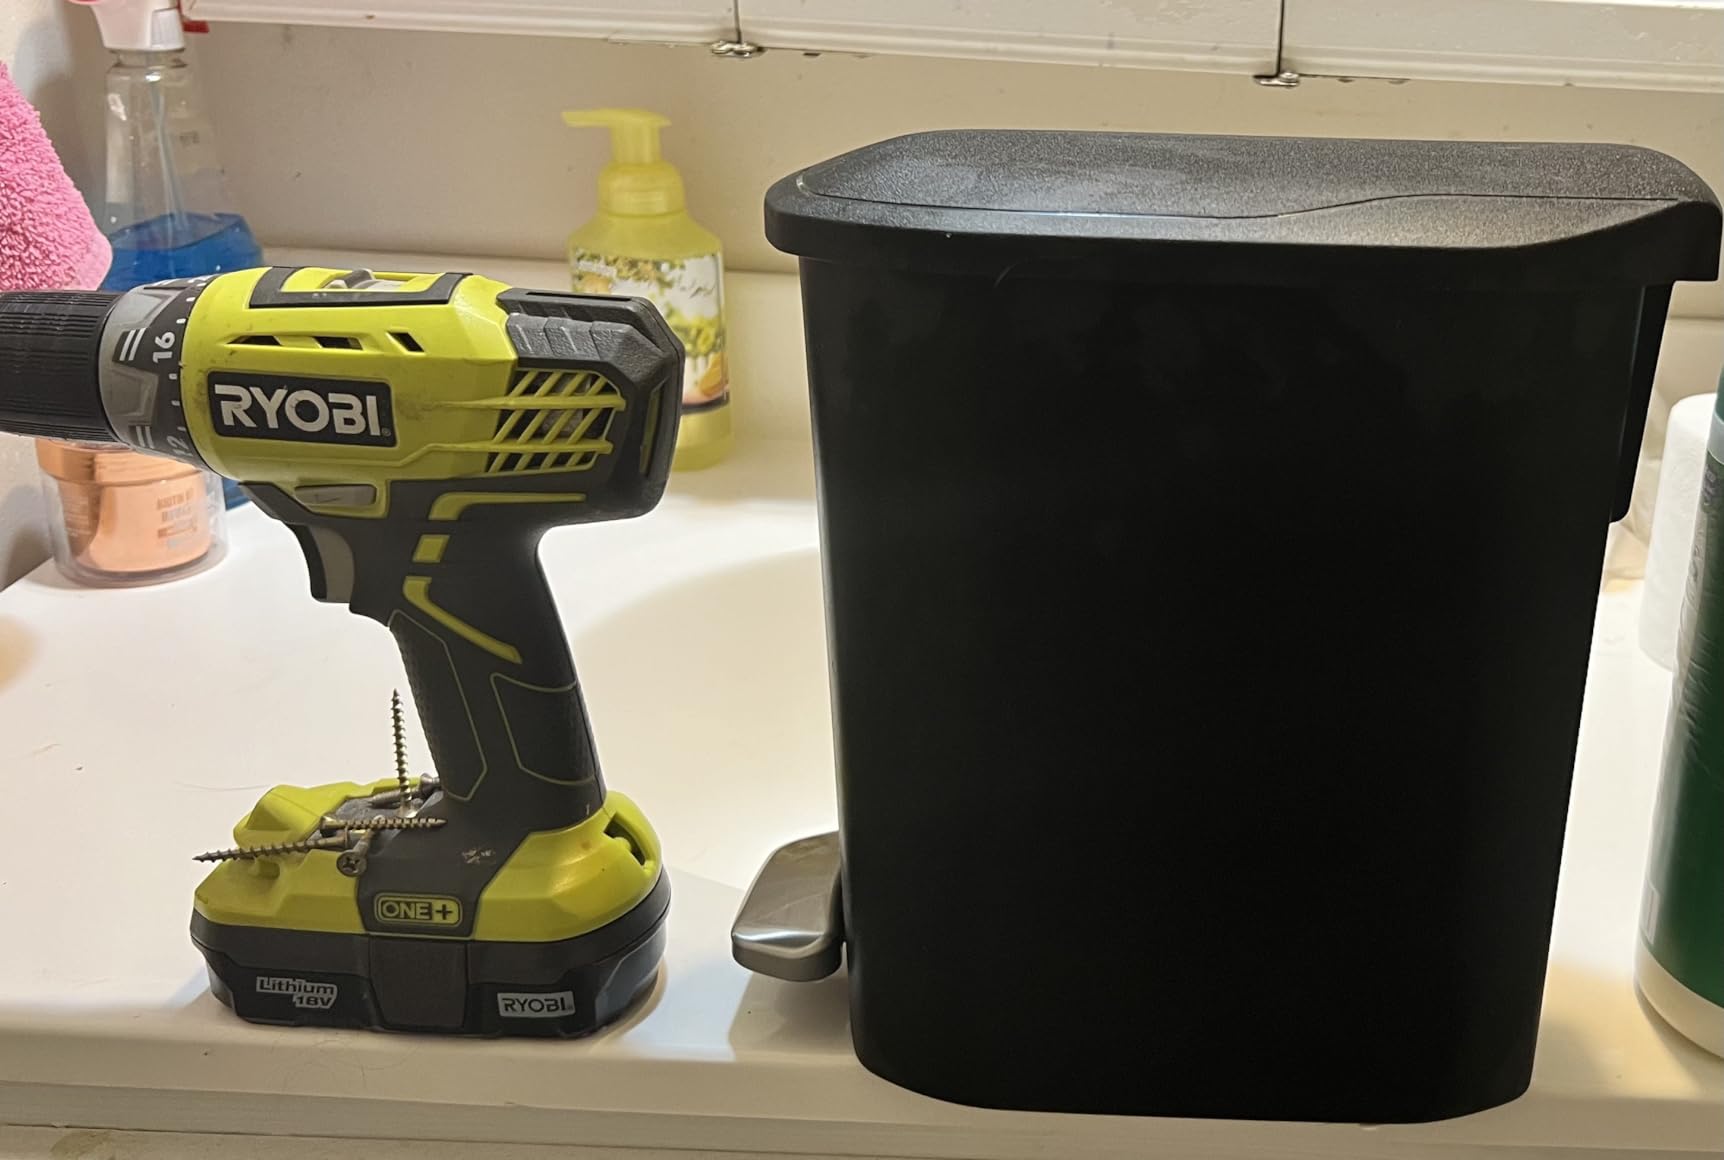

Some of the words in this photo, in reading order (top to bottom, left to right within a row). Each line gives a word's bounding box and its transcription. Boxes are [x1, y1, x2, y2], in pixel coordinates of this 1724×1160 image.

[152, 331, 176, 364] 16
[214, 384, 382, 436] RYOBI
[258, 978, 335, 995] Lithium
[296, 995, 333, 1007] 18V
[502, 997, 566, 1013] RYOBI
